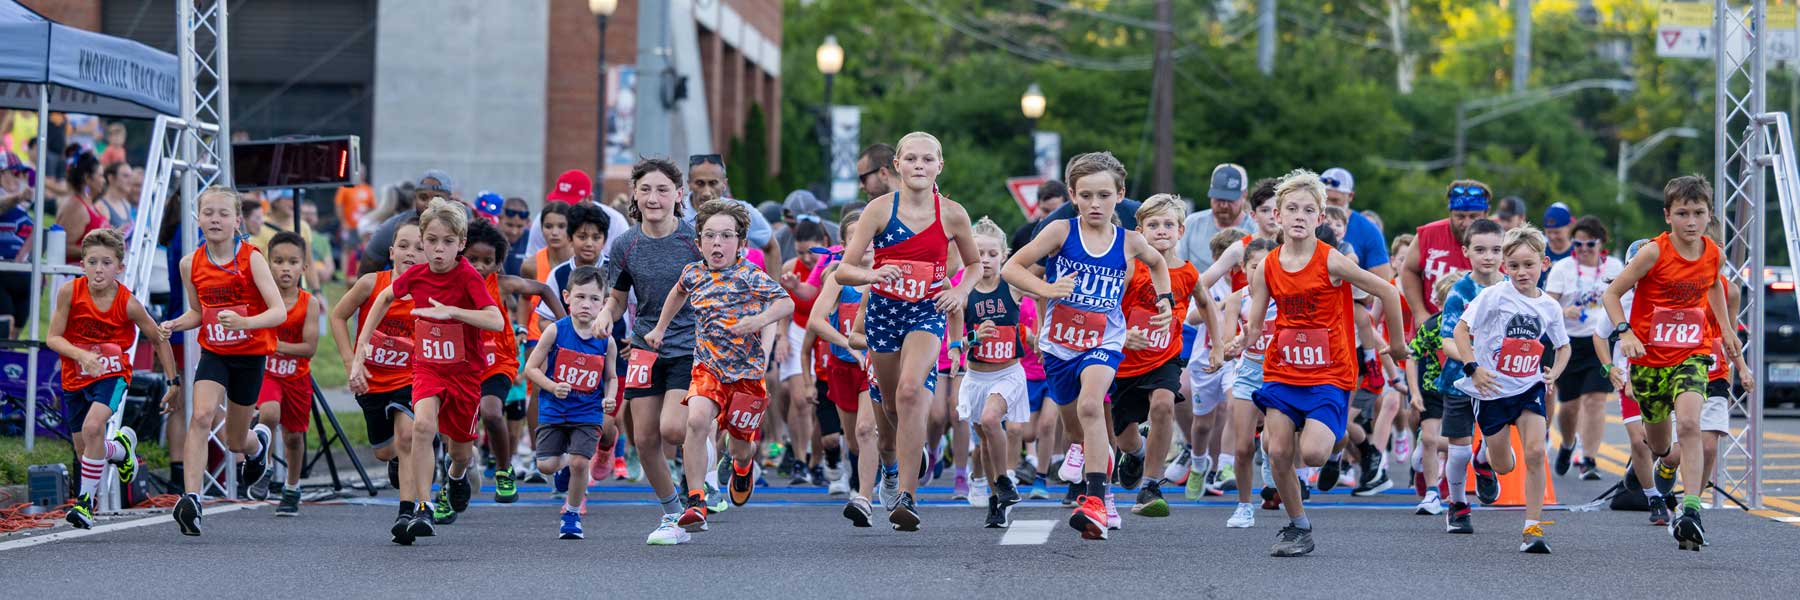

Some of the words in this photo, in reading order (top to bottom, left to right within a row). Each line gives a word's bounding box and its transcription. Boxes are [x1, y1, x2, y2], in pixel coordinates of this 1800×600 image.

[79, 49, 128, 88] KNOXVILLE
[131, 62, 157, 93] TRACK
[158, 73, 177, 104] CLUB
[1056, 255, 1126, 278] KNOXVILLE
[884, 275, 926, 299] 1431
[1056, 263, 1125, 298] YUTH
[975, 298, 1007, 317] USA
[1061, 293, 1117, 309] HLETICS
[1053, 322, 1099, 349] 1413
[1653, 322, 1700, 343] 1782
[422, 338, 455, 360] 510
[1282, 345, 1326, 365] 1191
[625, 364, 649, 384] 76
[1500, 354, 1540, 373] 1902
[557, 364, 599, 388] 1878
[729, 409, 766, 430] 194
